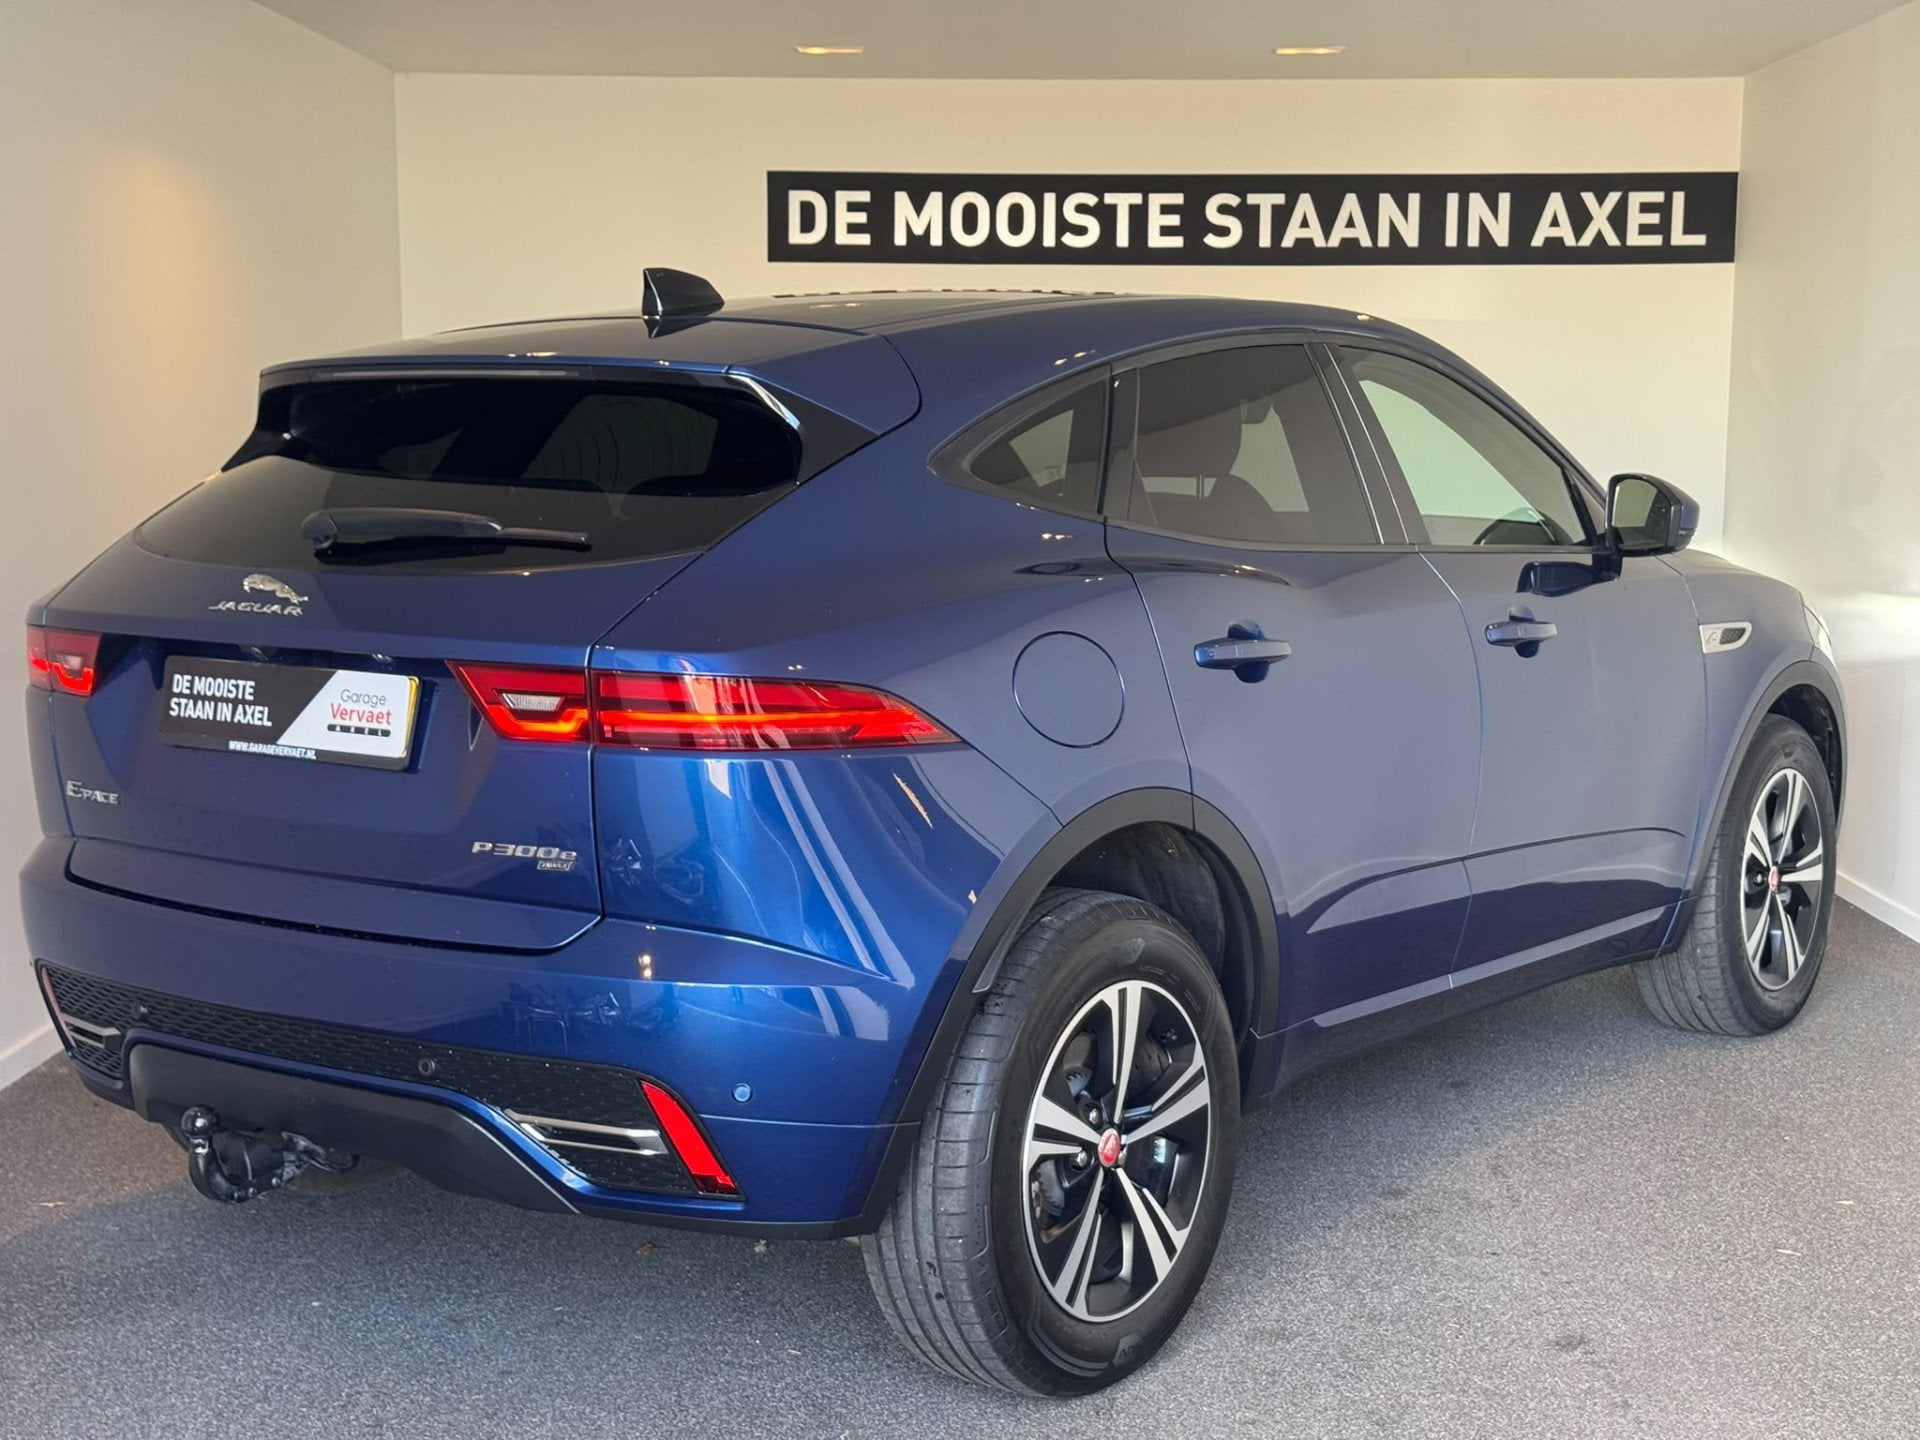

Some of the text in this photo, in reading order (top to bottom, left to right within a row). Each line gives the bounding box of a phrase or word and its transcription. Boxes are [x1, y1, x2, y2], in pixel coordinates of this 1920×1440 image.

[788, 189, 1708, 248] DE MOOISTE STAAN IN AXEL
[208, 601, 303, 617] JAGUAR
[172, 674, 255, 701] DE MOOISTE
[340, 688, 387, 708] Garage
[169, 697, 273, 727] STAAN IN AXEL
[330, 702, 392, 725] Vervaet
